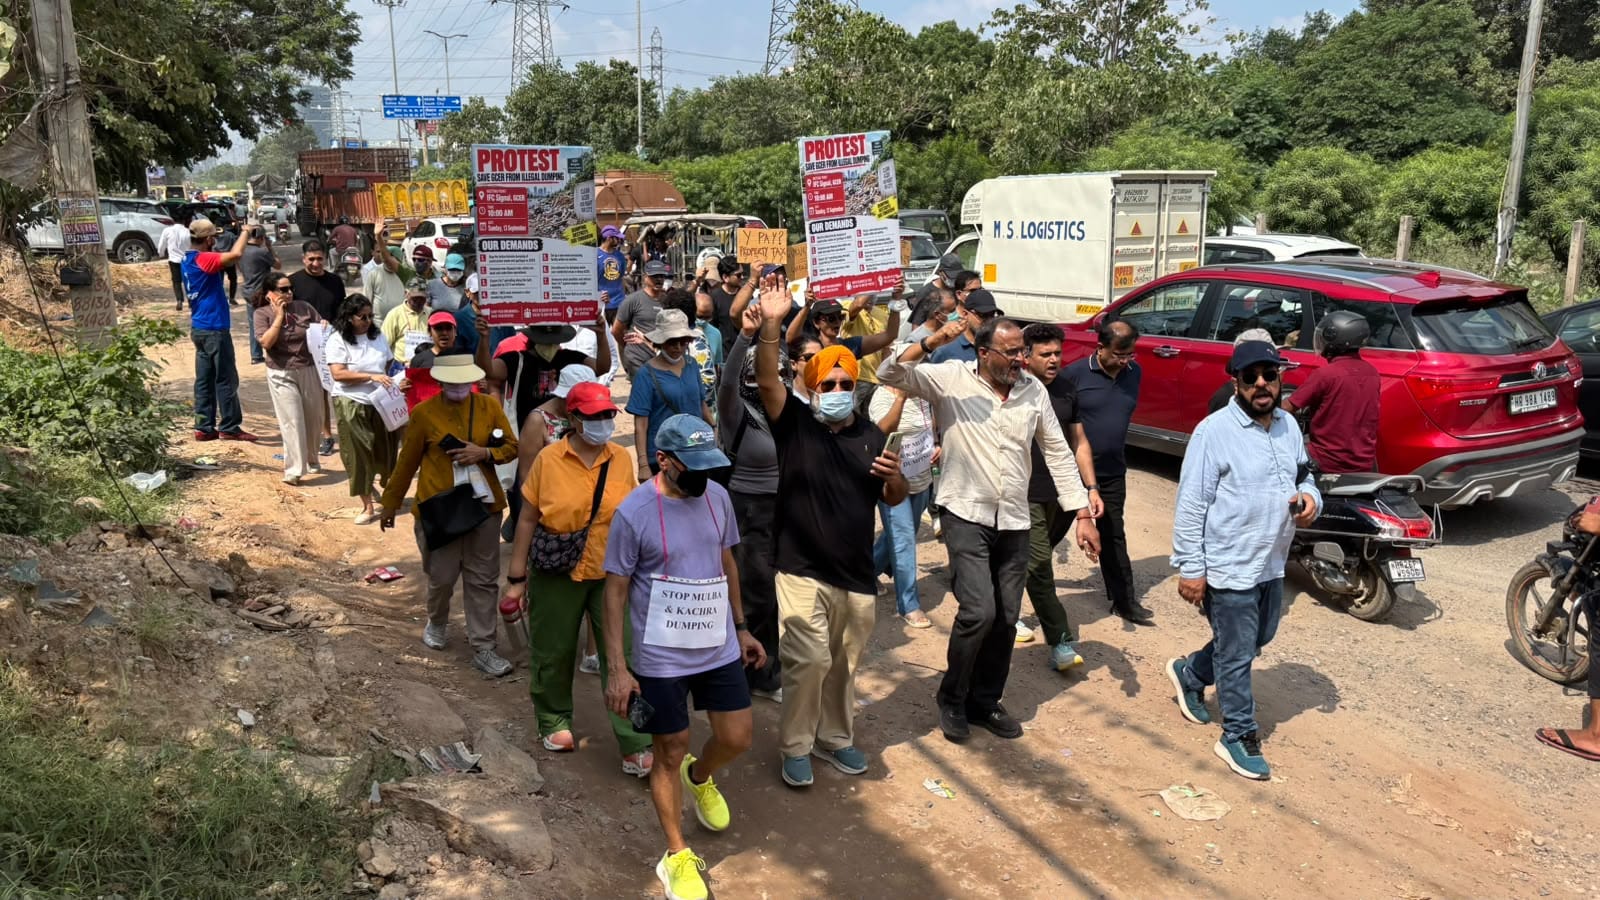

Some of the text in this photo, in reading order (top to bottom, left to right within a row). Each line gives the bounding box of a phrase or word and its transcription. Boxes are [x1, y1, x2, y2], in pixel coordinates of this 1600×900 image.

[804, 134, 866, 162] PROTEST
[477, 149, 560, 172] PROTEST
[806, 163, 815, 171] SAVE
[826, 159, 838, 168] FROM
[477, 173, 491, 182] SAVE
[506, 173, 520, 181] FROM
[522, 173, 540, 181] ILLEGAL
[542, 172, 565, 181] DUMPING
[487, 194, 495, 202] IFC
[496, 194, 512, 203] Signal,
[812, 219, 854, 232] OUR DEMANDS
[1021, 220, 1086, 241] LOGISTICS
[743, 230, 784, 245] Y PAY?
[482, 240, 538, 250] OUR DEMANDS
[770, 247, 786, 257] TAX
[1515, 396, 1522, 407] HR
[661, 590, 722, 602] STOP MULBA
[664, 606, 717, 616] & KACHRA
[666, 620, 714, 630] DUMPING
